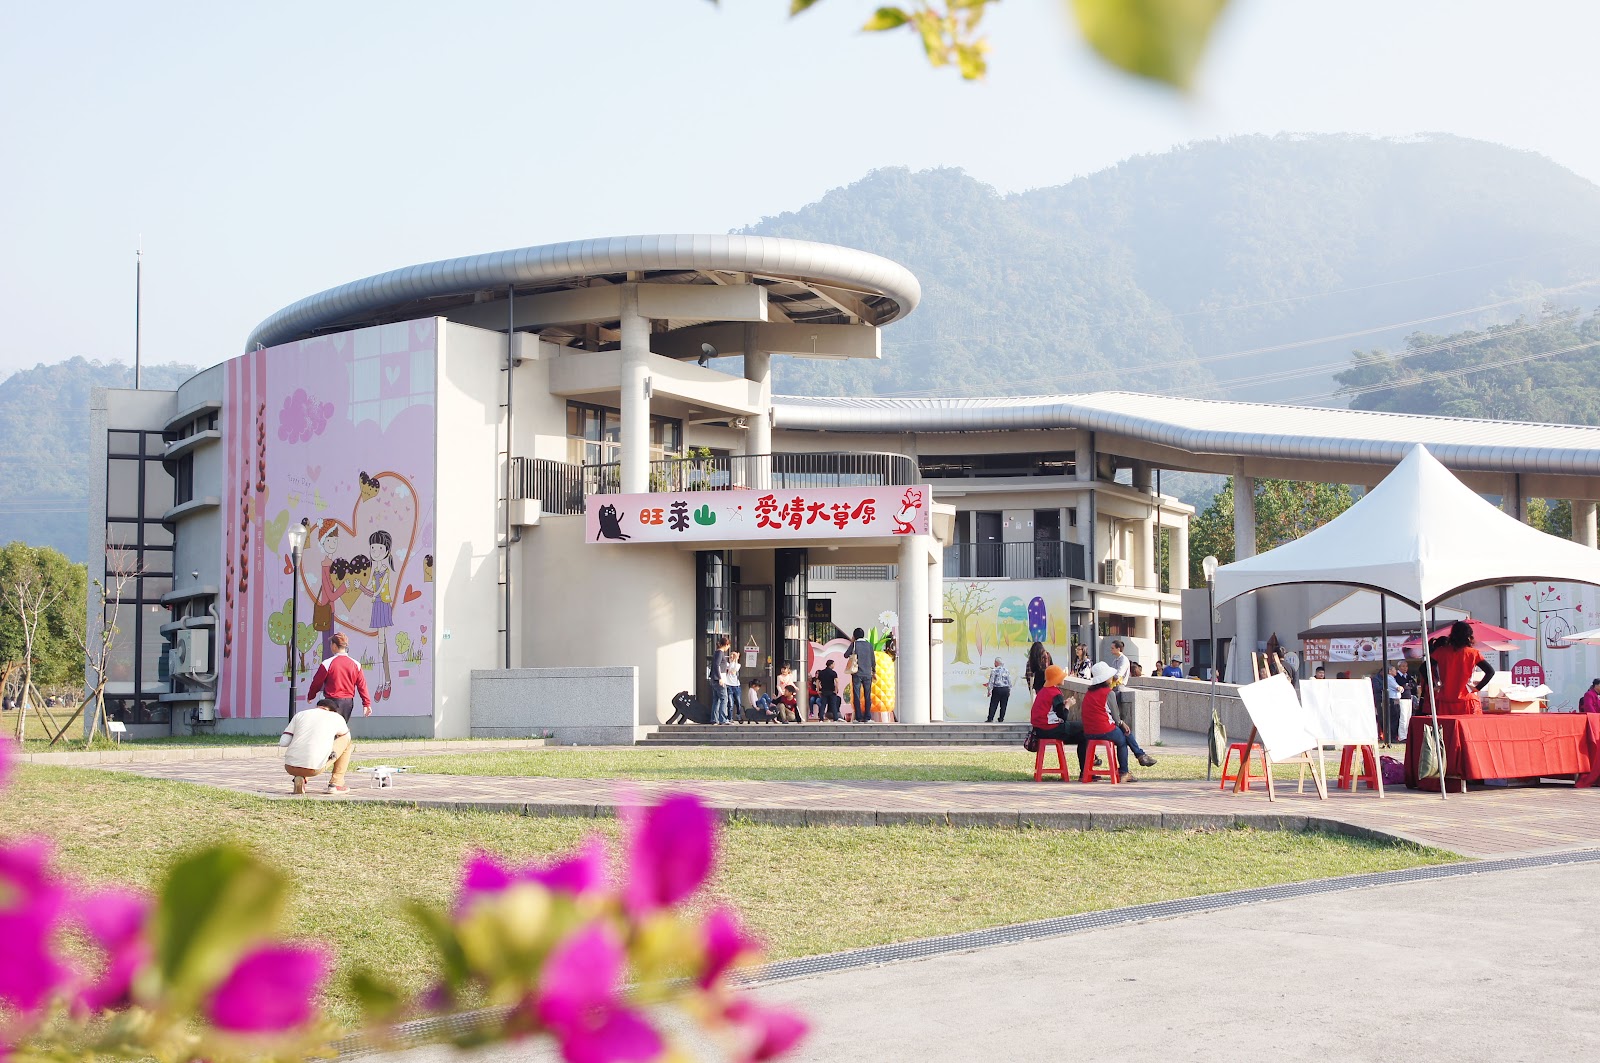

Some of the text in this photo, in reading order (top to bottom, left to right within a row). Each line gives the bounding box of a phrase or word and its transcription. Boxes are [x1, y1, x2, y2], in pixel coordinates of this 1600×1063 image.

[639, 493, 876, 532] 旺萊山 愛情大草原
[1514, 665, 1540, 675] 腳踏車
[1515, 676, 1540, 688] 出租
